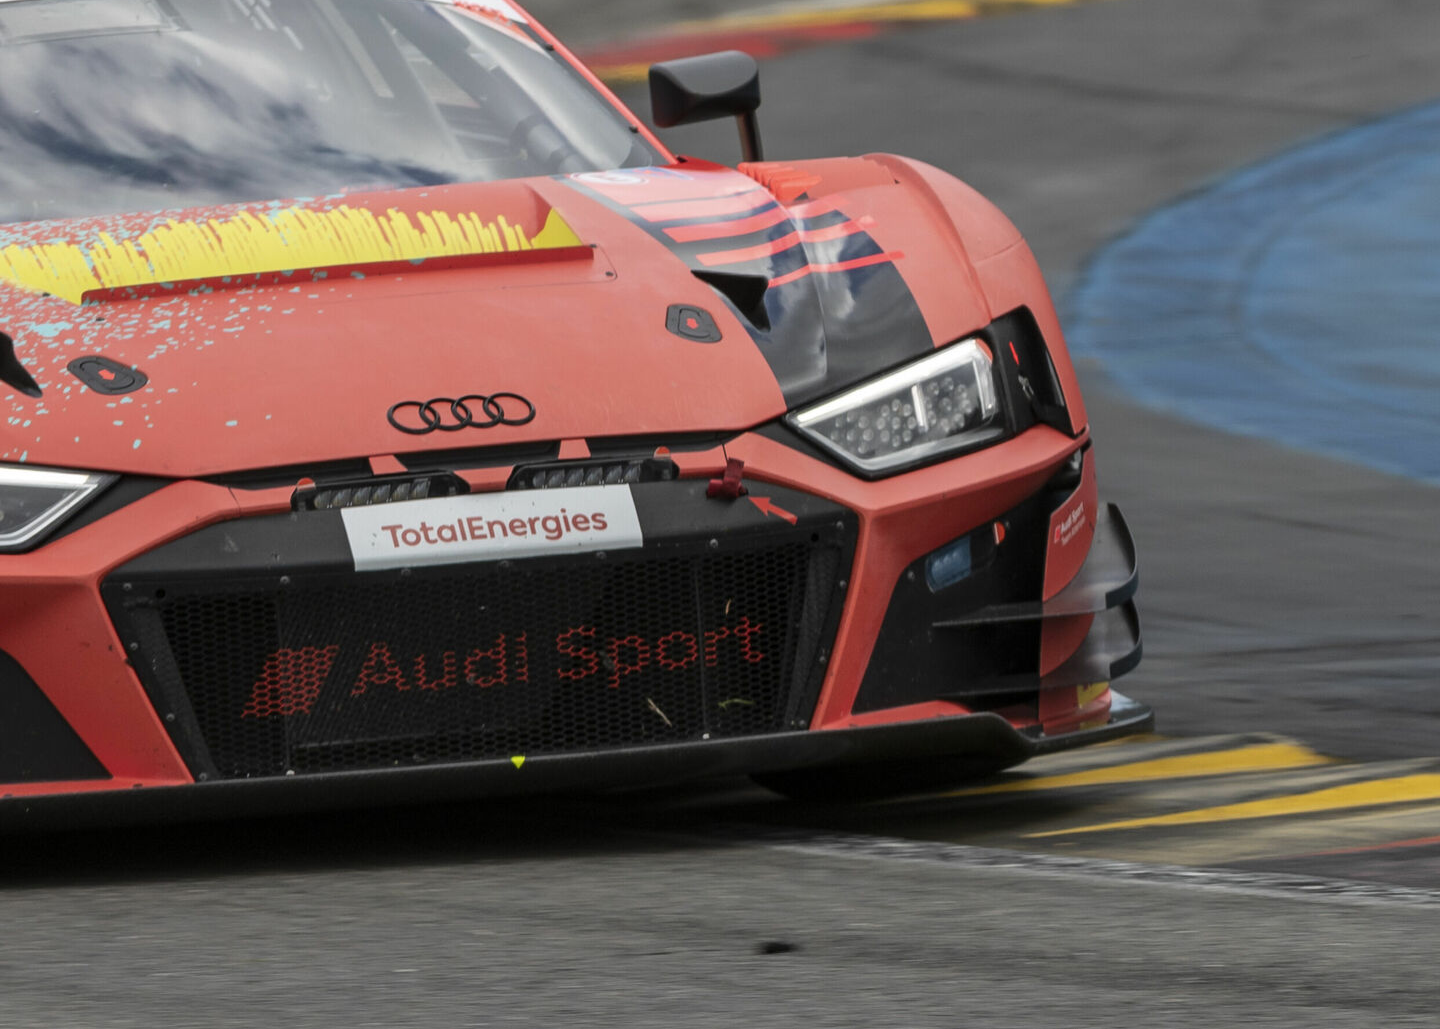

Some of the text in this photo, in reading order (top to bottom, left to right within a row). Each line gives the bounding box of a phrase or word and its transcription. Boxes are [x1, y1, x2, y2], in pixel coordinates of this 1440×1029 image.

[381, 508, 608, 549] TotalEnergies
[350, 616, 763, 698] Audi Sport
